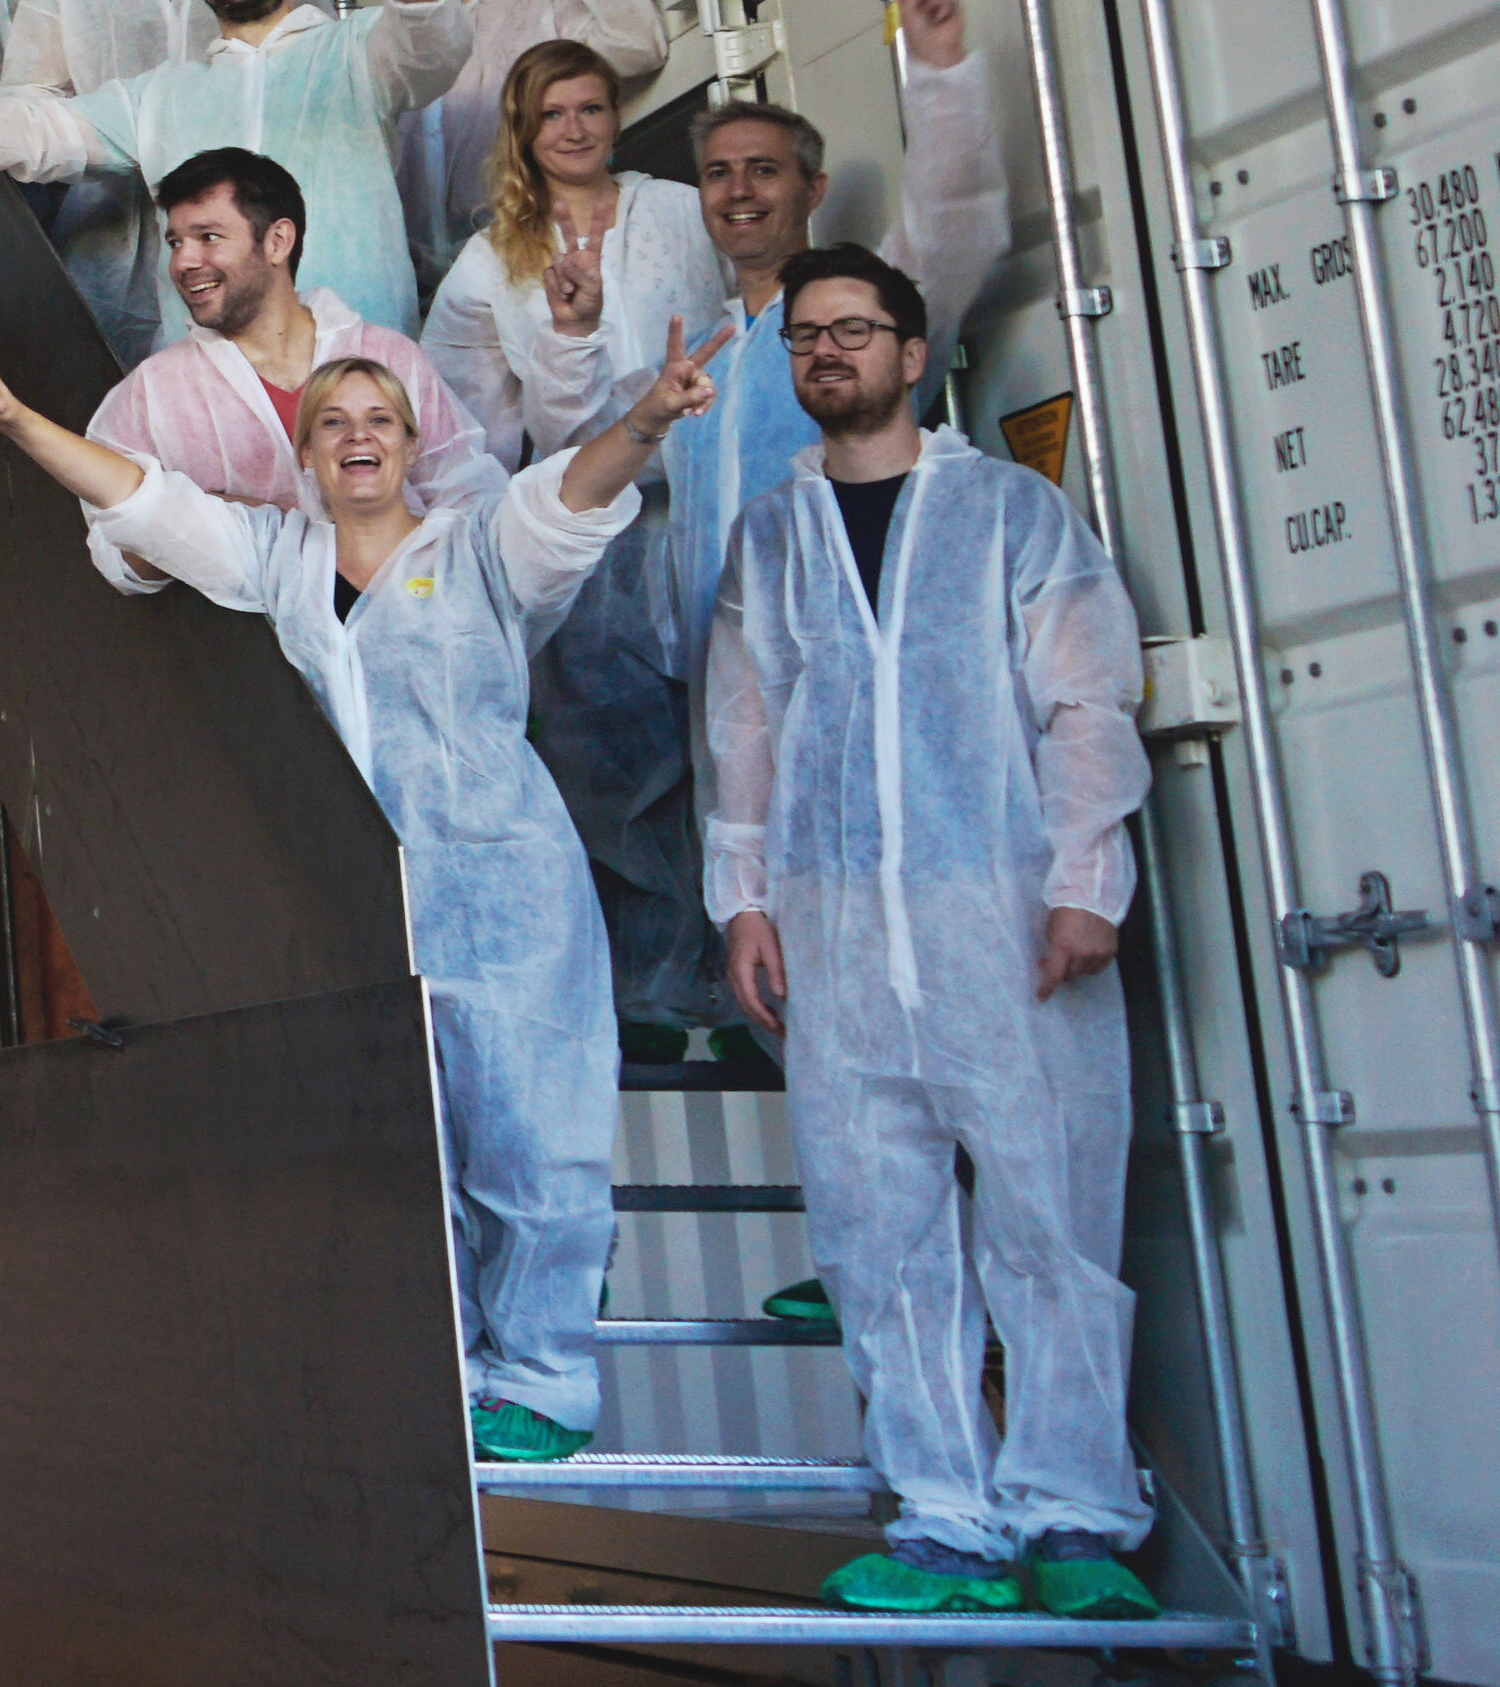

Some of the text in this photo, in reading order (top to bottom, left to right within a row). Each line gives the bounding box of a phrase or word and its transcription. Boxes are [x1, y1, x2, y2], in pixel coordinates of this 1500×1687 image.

[1248, 263, 1290, 311] MAX.
[1261, 341, 1305, 391] TARE
[1273, 427, 1306, 473] NET
[1285, 501, 1352, 554] CU.CAP.
